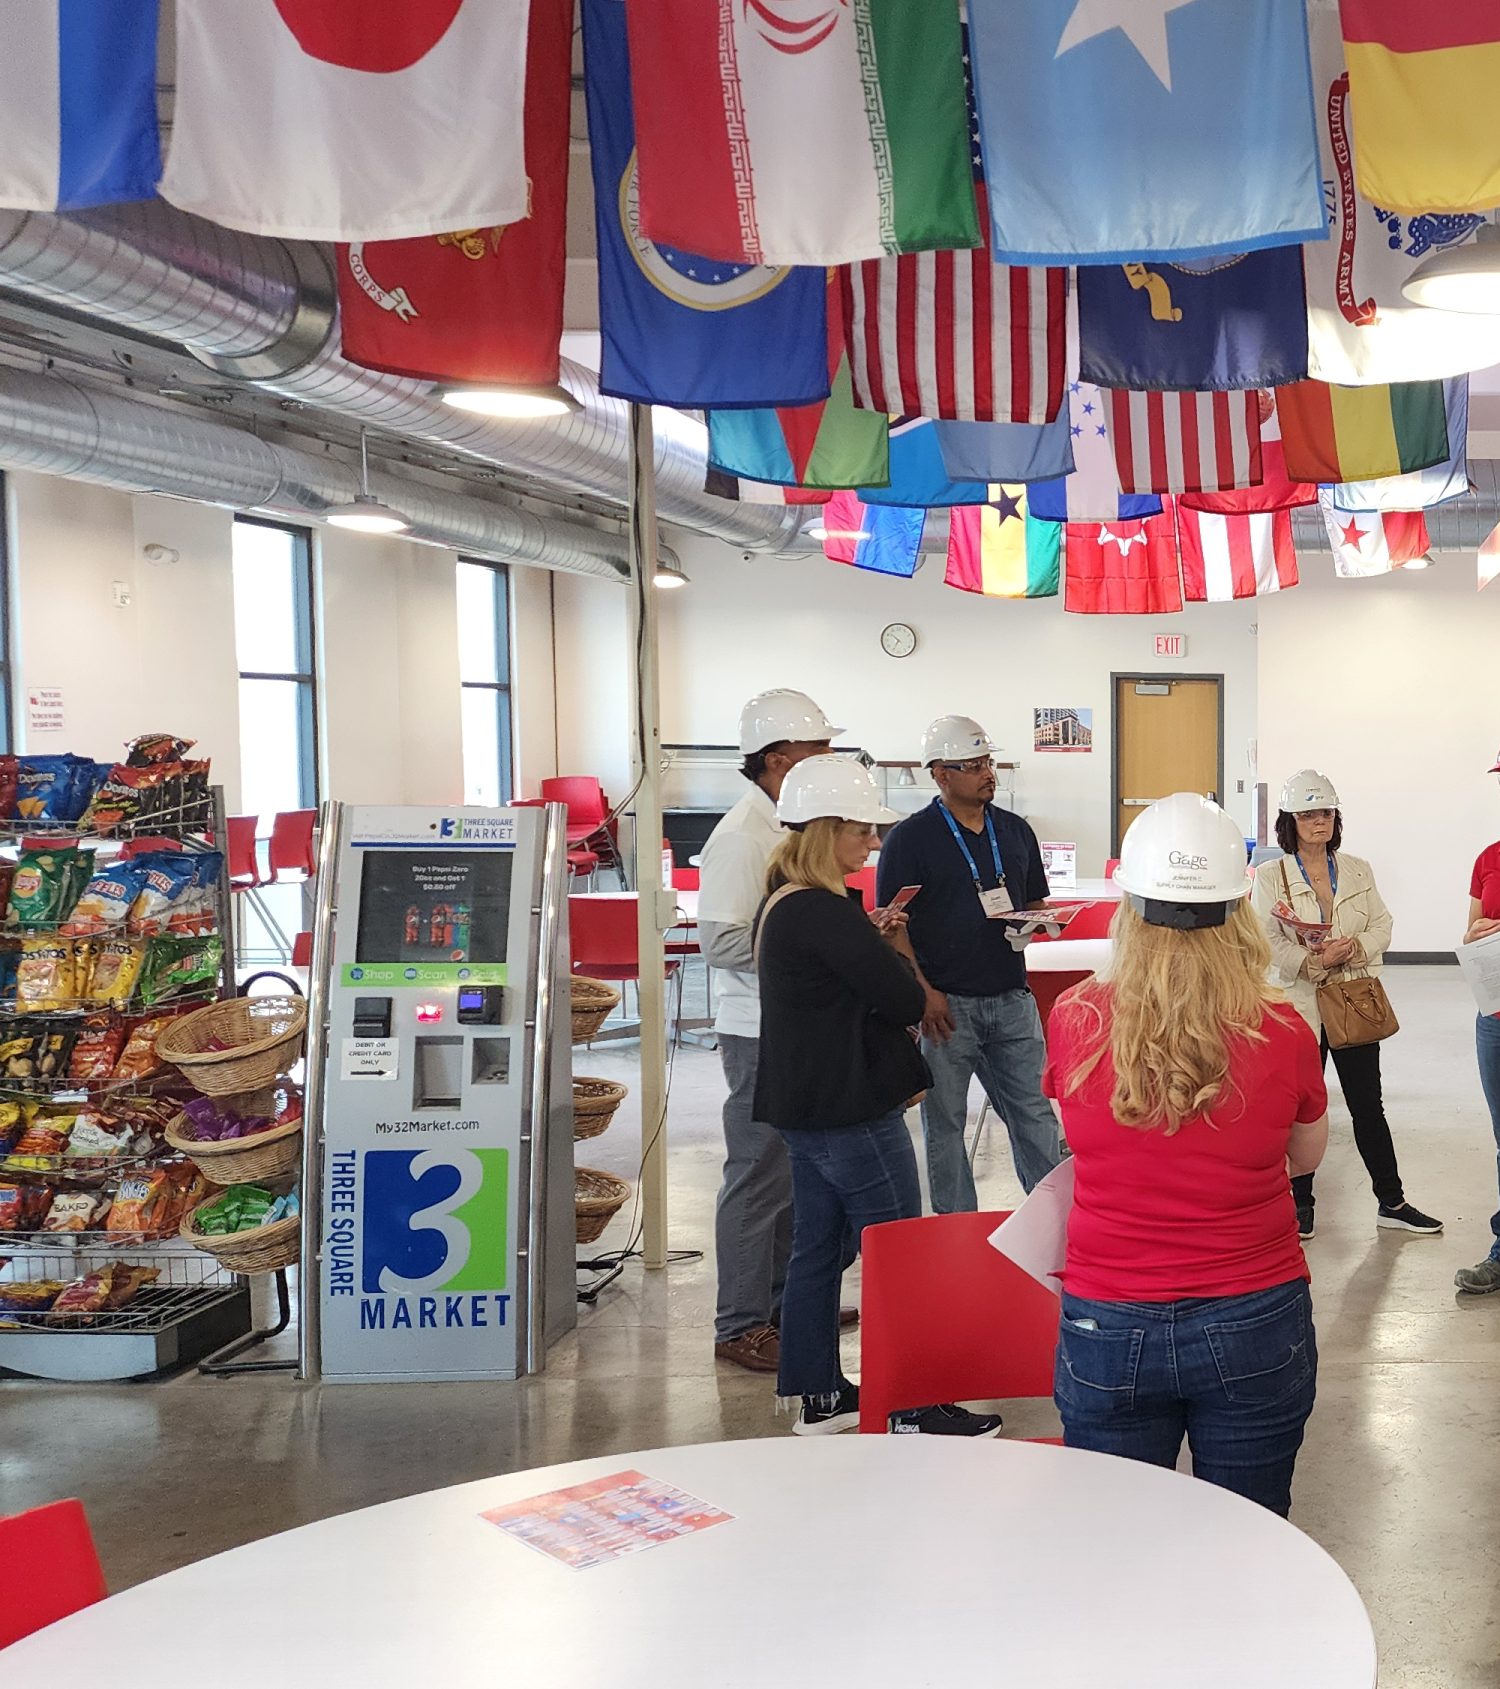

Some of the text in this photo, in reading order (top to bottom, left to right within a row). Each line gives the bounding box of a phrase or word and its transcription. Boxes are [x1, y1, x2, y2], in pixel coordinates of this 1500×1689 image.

[1322, 180, 1337, 226] 1775
[1330, 94, 1356, 308] UNITED STATES ARMY
[351, 254, 385, 302] CORPS
[1156, 636, 1181, 654] EXIT
[486, 818, 513, 826] SQUARE
[463, 828, 513, 840] MARKET
[1168, 850, 1208, 870] Gage
[412, 866, 426, 874] Buy
[365, 970, 447, 980] Shop Scan
[376, 1120, 480, 1134] My32Market.com
[54, 1202, 89, 1213] BAKED
[326, 1150, 356, 1297] THREE SQUARE
[360, 1294, 511, 1330] MARKET
[894, 1423, 920, 1434] HOKA
